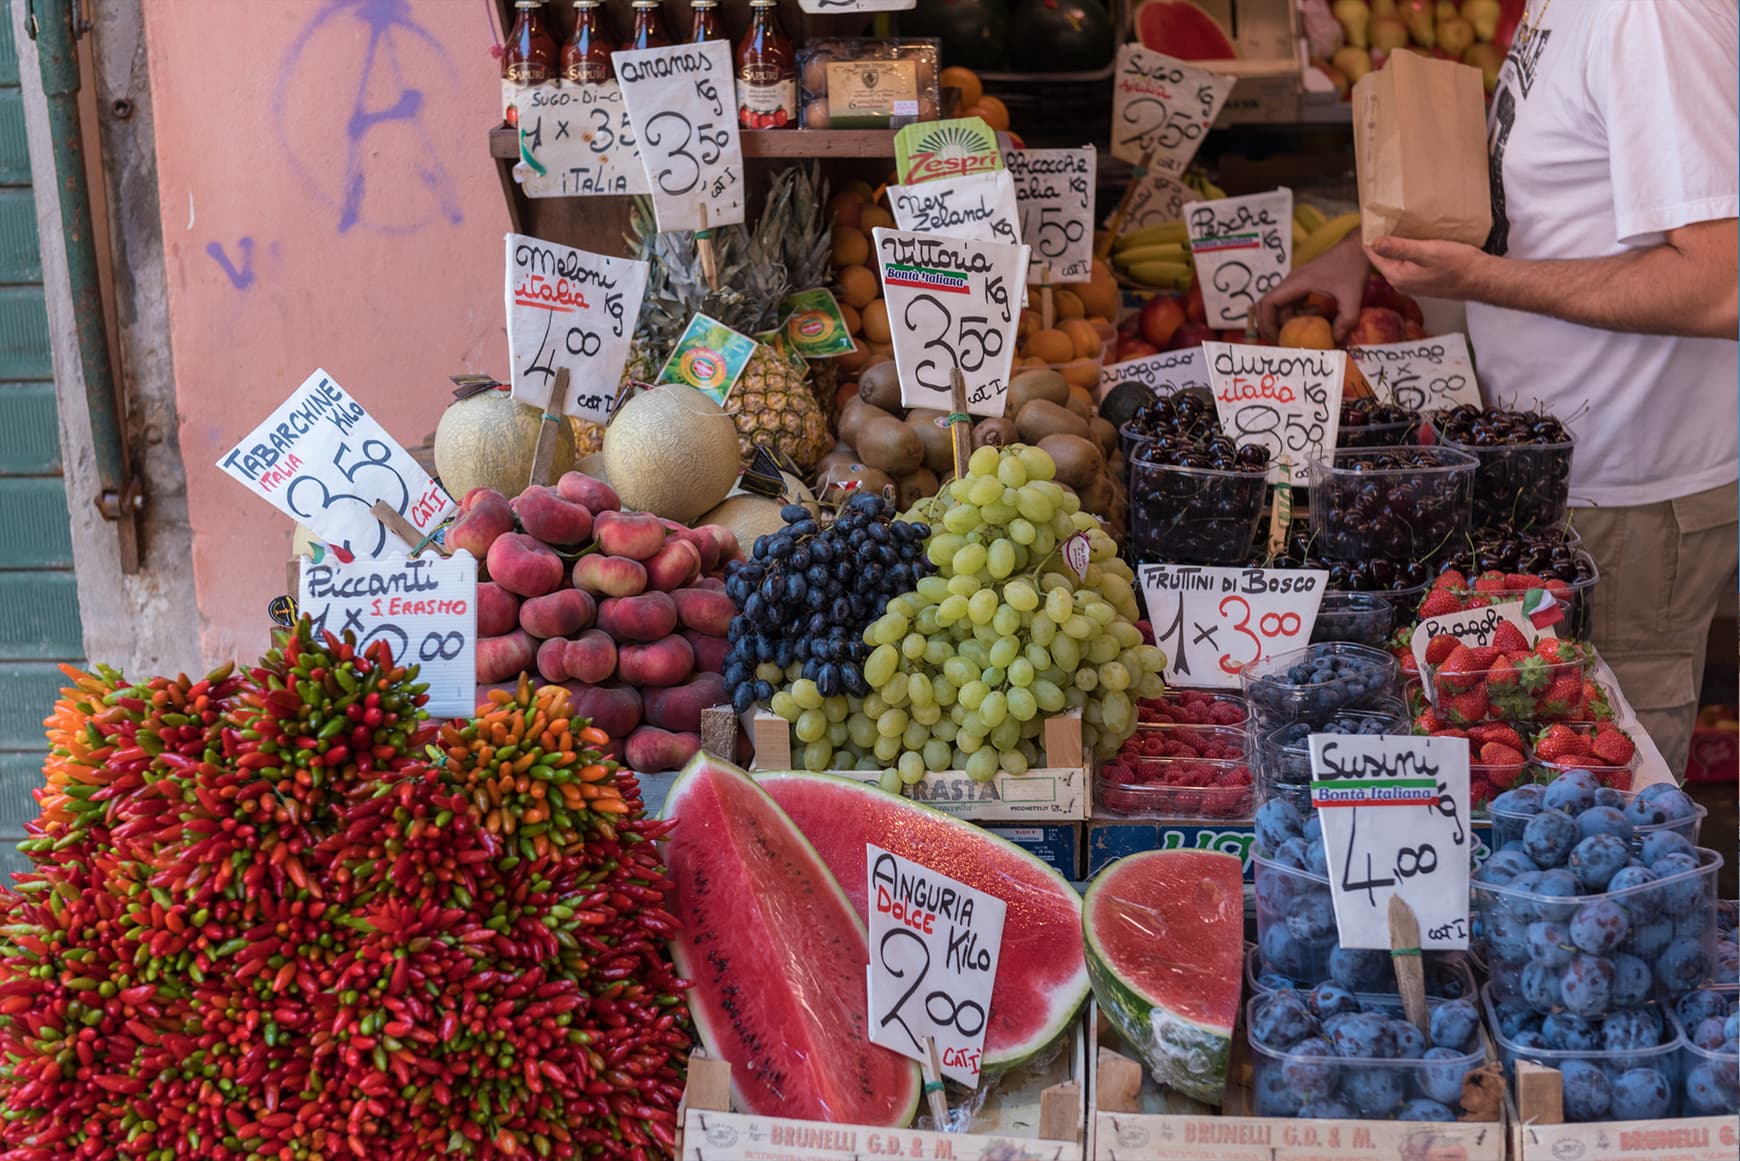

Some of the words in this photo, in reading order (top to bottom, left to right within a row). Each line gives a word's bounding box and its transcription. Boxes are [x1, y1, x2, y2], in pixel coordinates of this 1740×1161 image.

[620, 52, 712, 82] ananas
[524, 116, 542, 152] 1
[905, 150, 998, 185] Zespri
[516, 244, 617, 289] Meloni
[881, 238, 994, 273] Vittoria
[514, 274, 590, 309] italia
[888, 268, 918, 280] Bontà
[1215, 344, 1334, 377] duroni
[1218, 374, 1296, 403] italia
[222, 378, 343, 481] TABARCHINE
[258, 453, 304, 493] ITALIA
[306, 560, 439, 598] Piccanti
[1144, 566, 1214, 591] FRUTTINI
[1241, 569, 1317, 594] BOSCO
[388, 598, 468, 616] ERASMO
[1159, 592, 1192, 676] 1
[1317, 738, 1439, 780] Susini
[1318, 787, 1366, 800] Bontà
[1370, 786, 1432, 800] Italiana
[872, 853, 974, 927] ANGURIA
[877, 884, 936, 935] DOLCE
[770, 1124, 856, 1153] BRUNELLI
[910, 1136, 924, 1158] &
[1184, 1120, 1271, 1146] BRUNELLI
[1328, 1126, 1342, 1148] &
[1619, 1127, 1709, 1152] BRUNELLI
